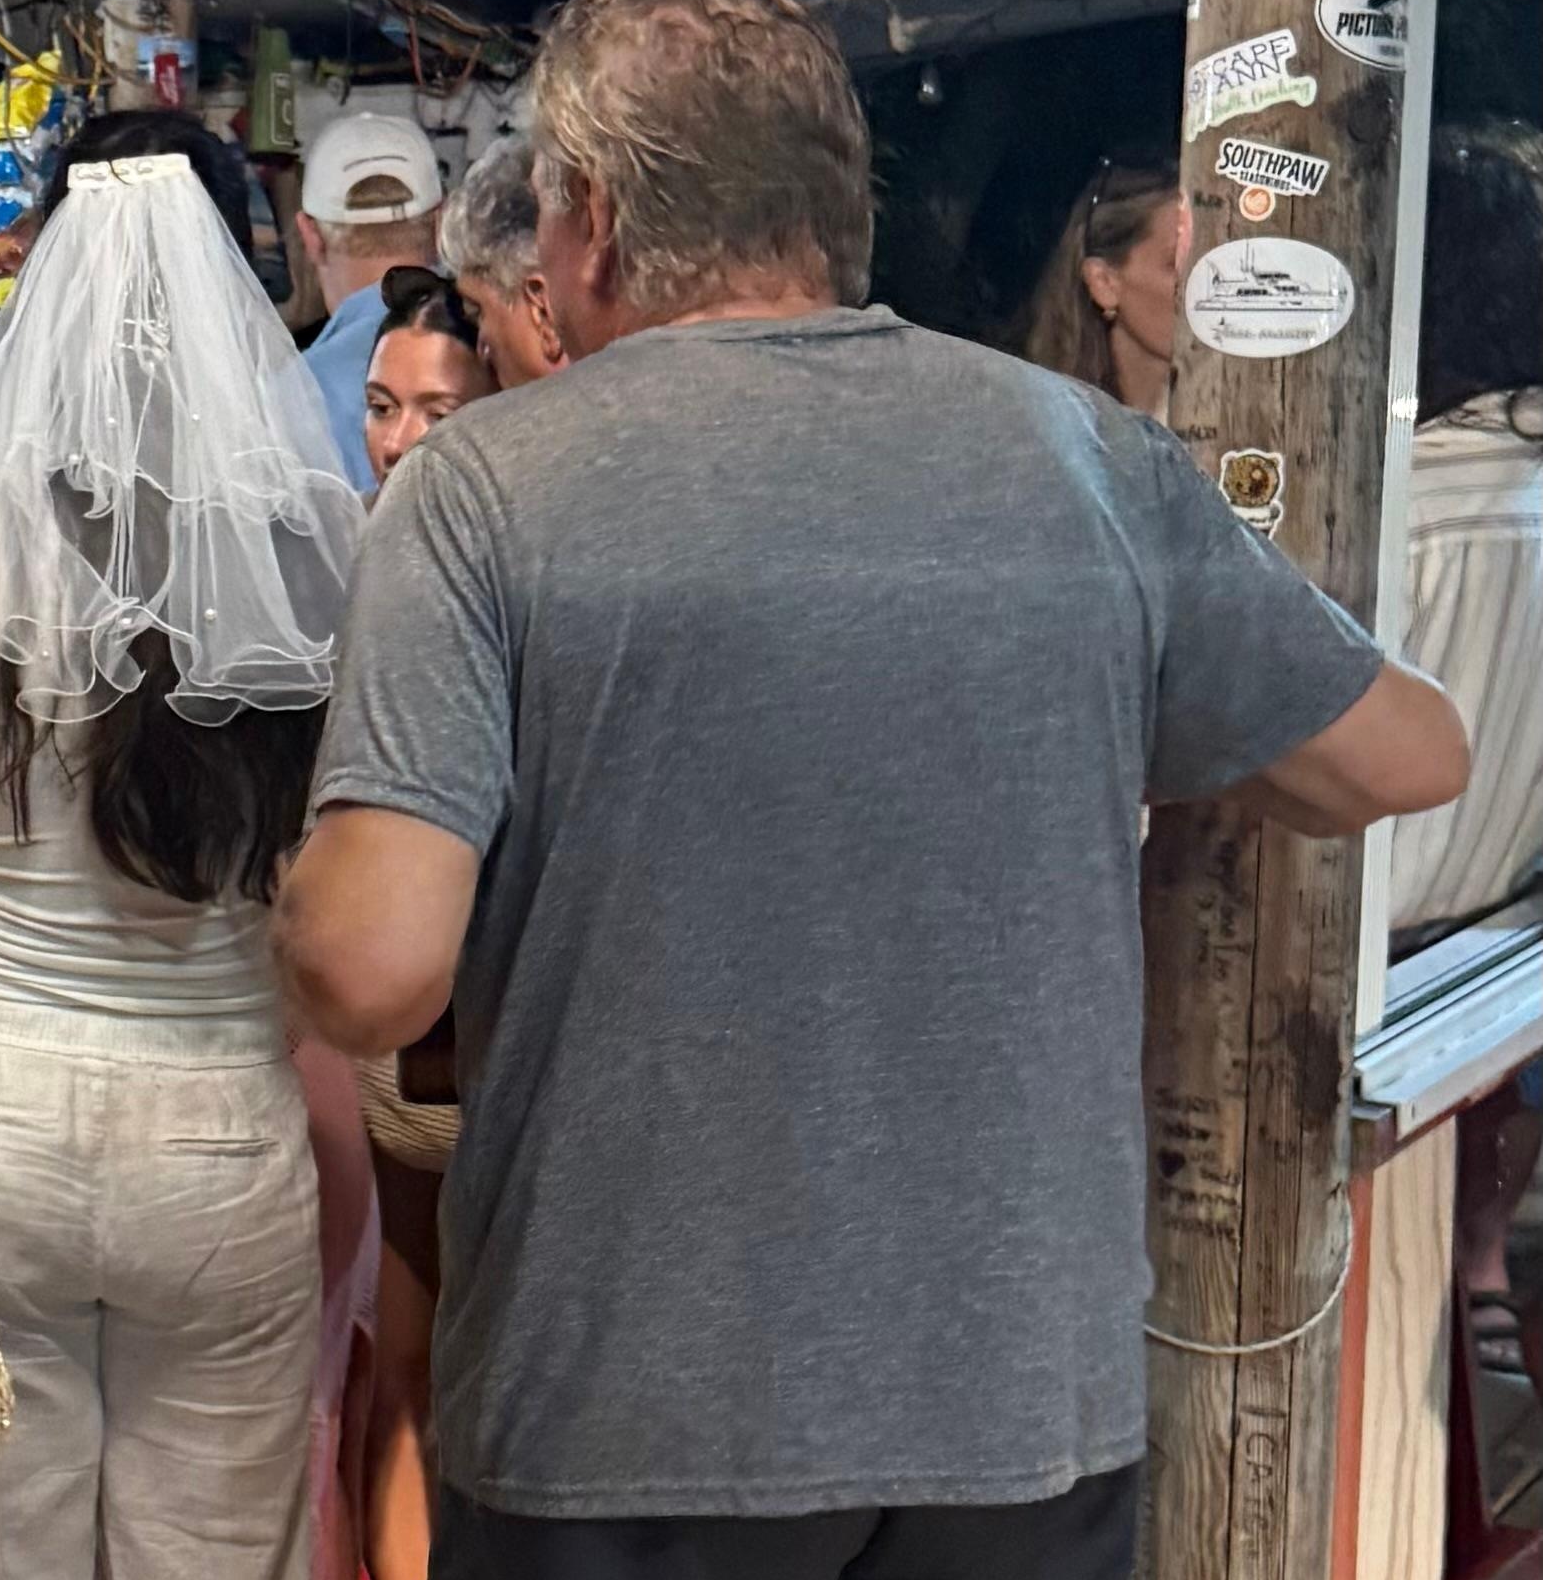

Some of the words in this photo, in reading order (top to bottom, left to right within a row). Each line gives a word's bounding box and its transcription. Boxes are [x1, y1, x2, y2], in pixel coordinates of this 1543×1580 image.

[1211, 36, 1291, 77] CAPE
[1214, 55, 1284, 95] ANN
[1219, 141, 1325, 191] SOUTHPAW
